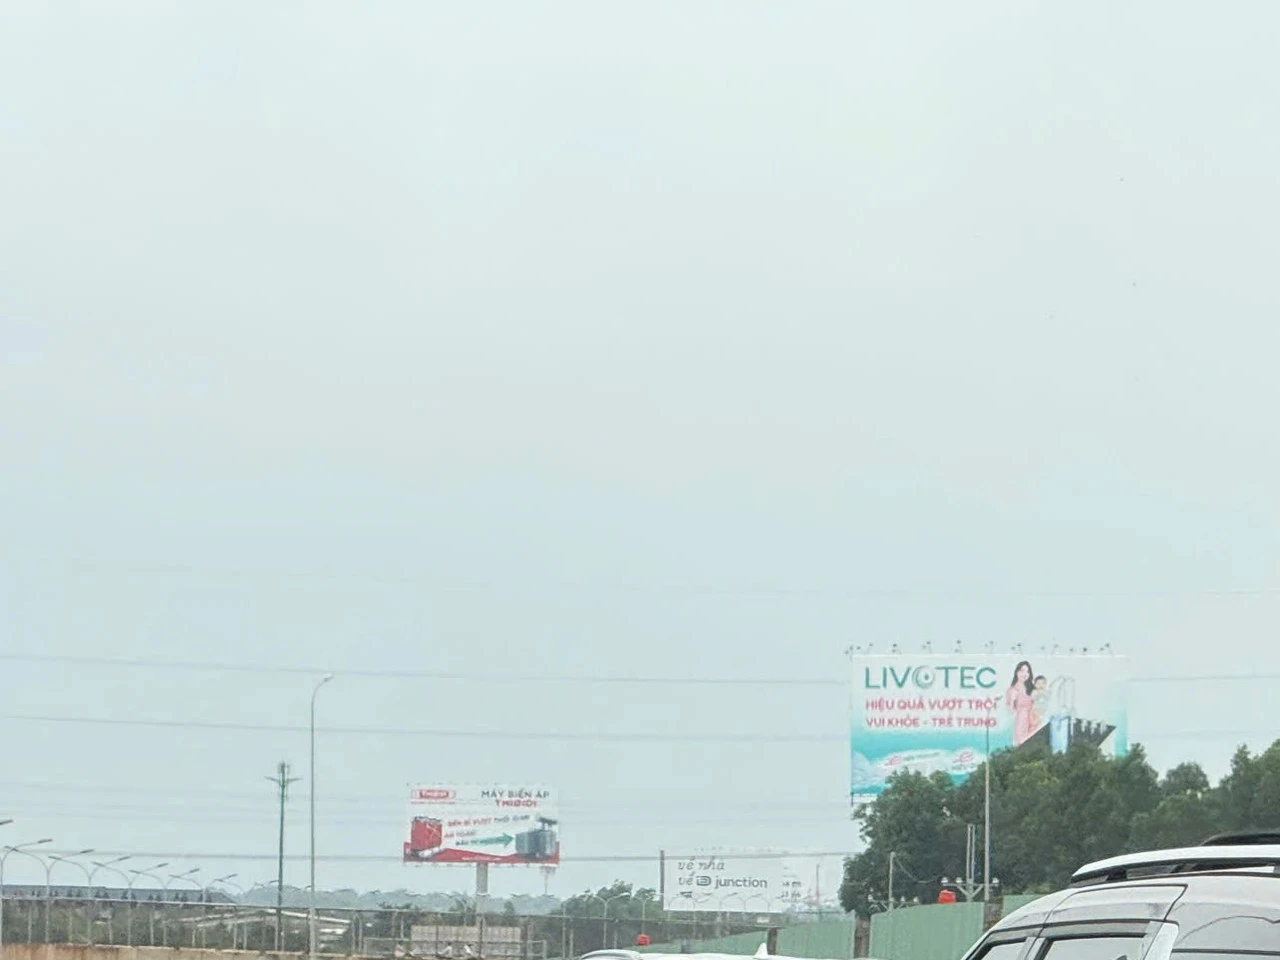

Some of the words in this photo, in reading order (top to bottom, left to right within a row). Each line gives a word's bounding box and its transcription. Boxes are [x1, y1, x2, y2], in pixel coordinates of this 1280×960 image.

[864, 666, 997, 690] LIVOTEC
[867, 717, 885, 727] VUI
[957, 717, 997, 728] TRUNG
[715, 875, 768, 889] junction
